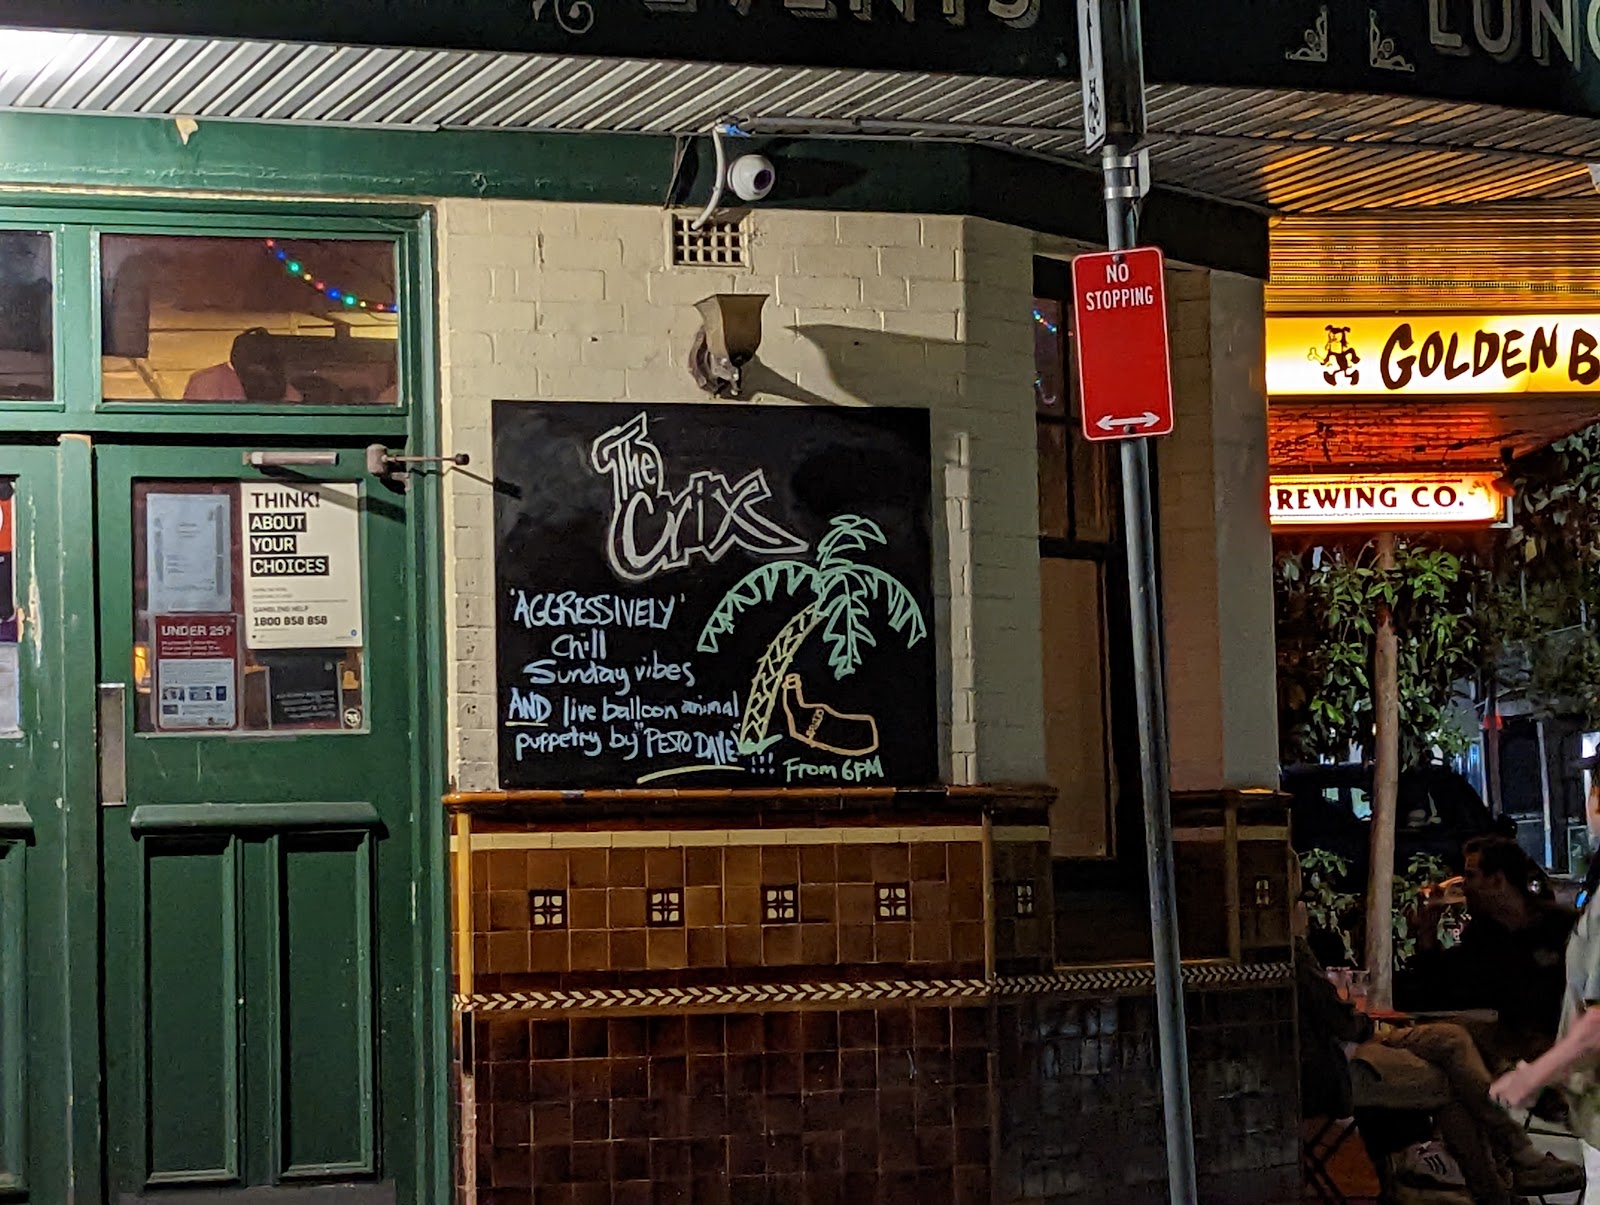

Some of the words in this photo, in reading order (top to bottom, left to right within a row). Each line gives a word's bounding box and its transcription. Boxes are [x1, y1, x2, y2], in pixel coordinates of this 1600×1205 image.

[1106, 263, 1129, 284] NO
[1085, 286, 1154, 311] STOPPING
[1380, 322, 1558, 390] GOLDEN
[602, 425, 656, 500] The
[250, 492, 320, 508] THINK!
[1268, 486, 1397, 510] REWING
[1411, 486, 1464, 507] CO.
[251, 515, 304, 530] ABOUT
[622, 479, 783, 568] Crix
[251, 537, 295, 552] YOUR
[252, 558, 326, 574] CHOICES
[161, 625, 207, 636] UNDER
[209, 625, 232, 636] 25?
[254, 617, 281, 627] 1800
[284, 616, 305, 626] 858
[307, 615, 328, 625] 858
[551, 627, 607, 660] Chill
[523, 659, 631, 696] Sunday
[634, 650, 696, 687] vibes
[508, 687, 552, 723] AND
[563, 695, 596, 727] live
[602, 695, 678, 722] balloon
[681, 691, 739, 717] animal
[515, 726, 602, 761] puppetry
[609, 725, 638, 760] by
[783, 757, 838, 782] From
[841, 755, 884, 782] 6PM
